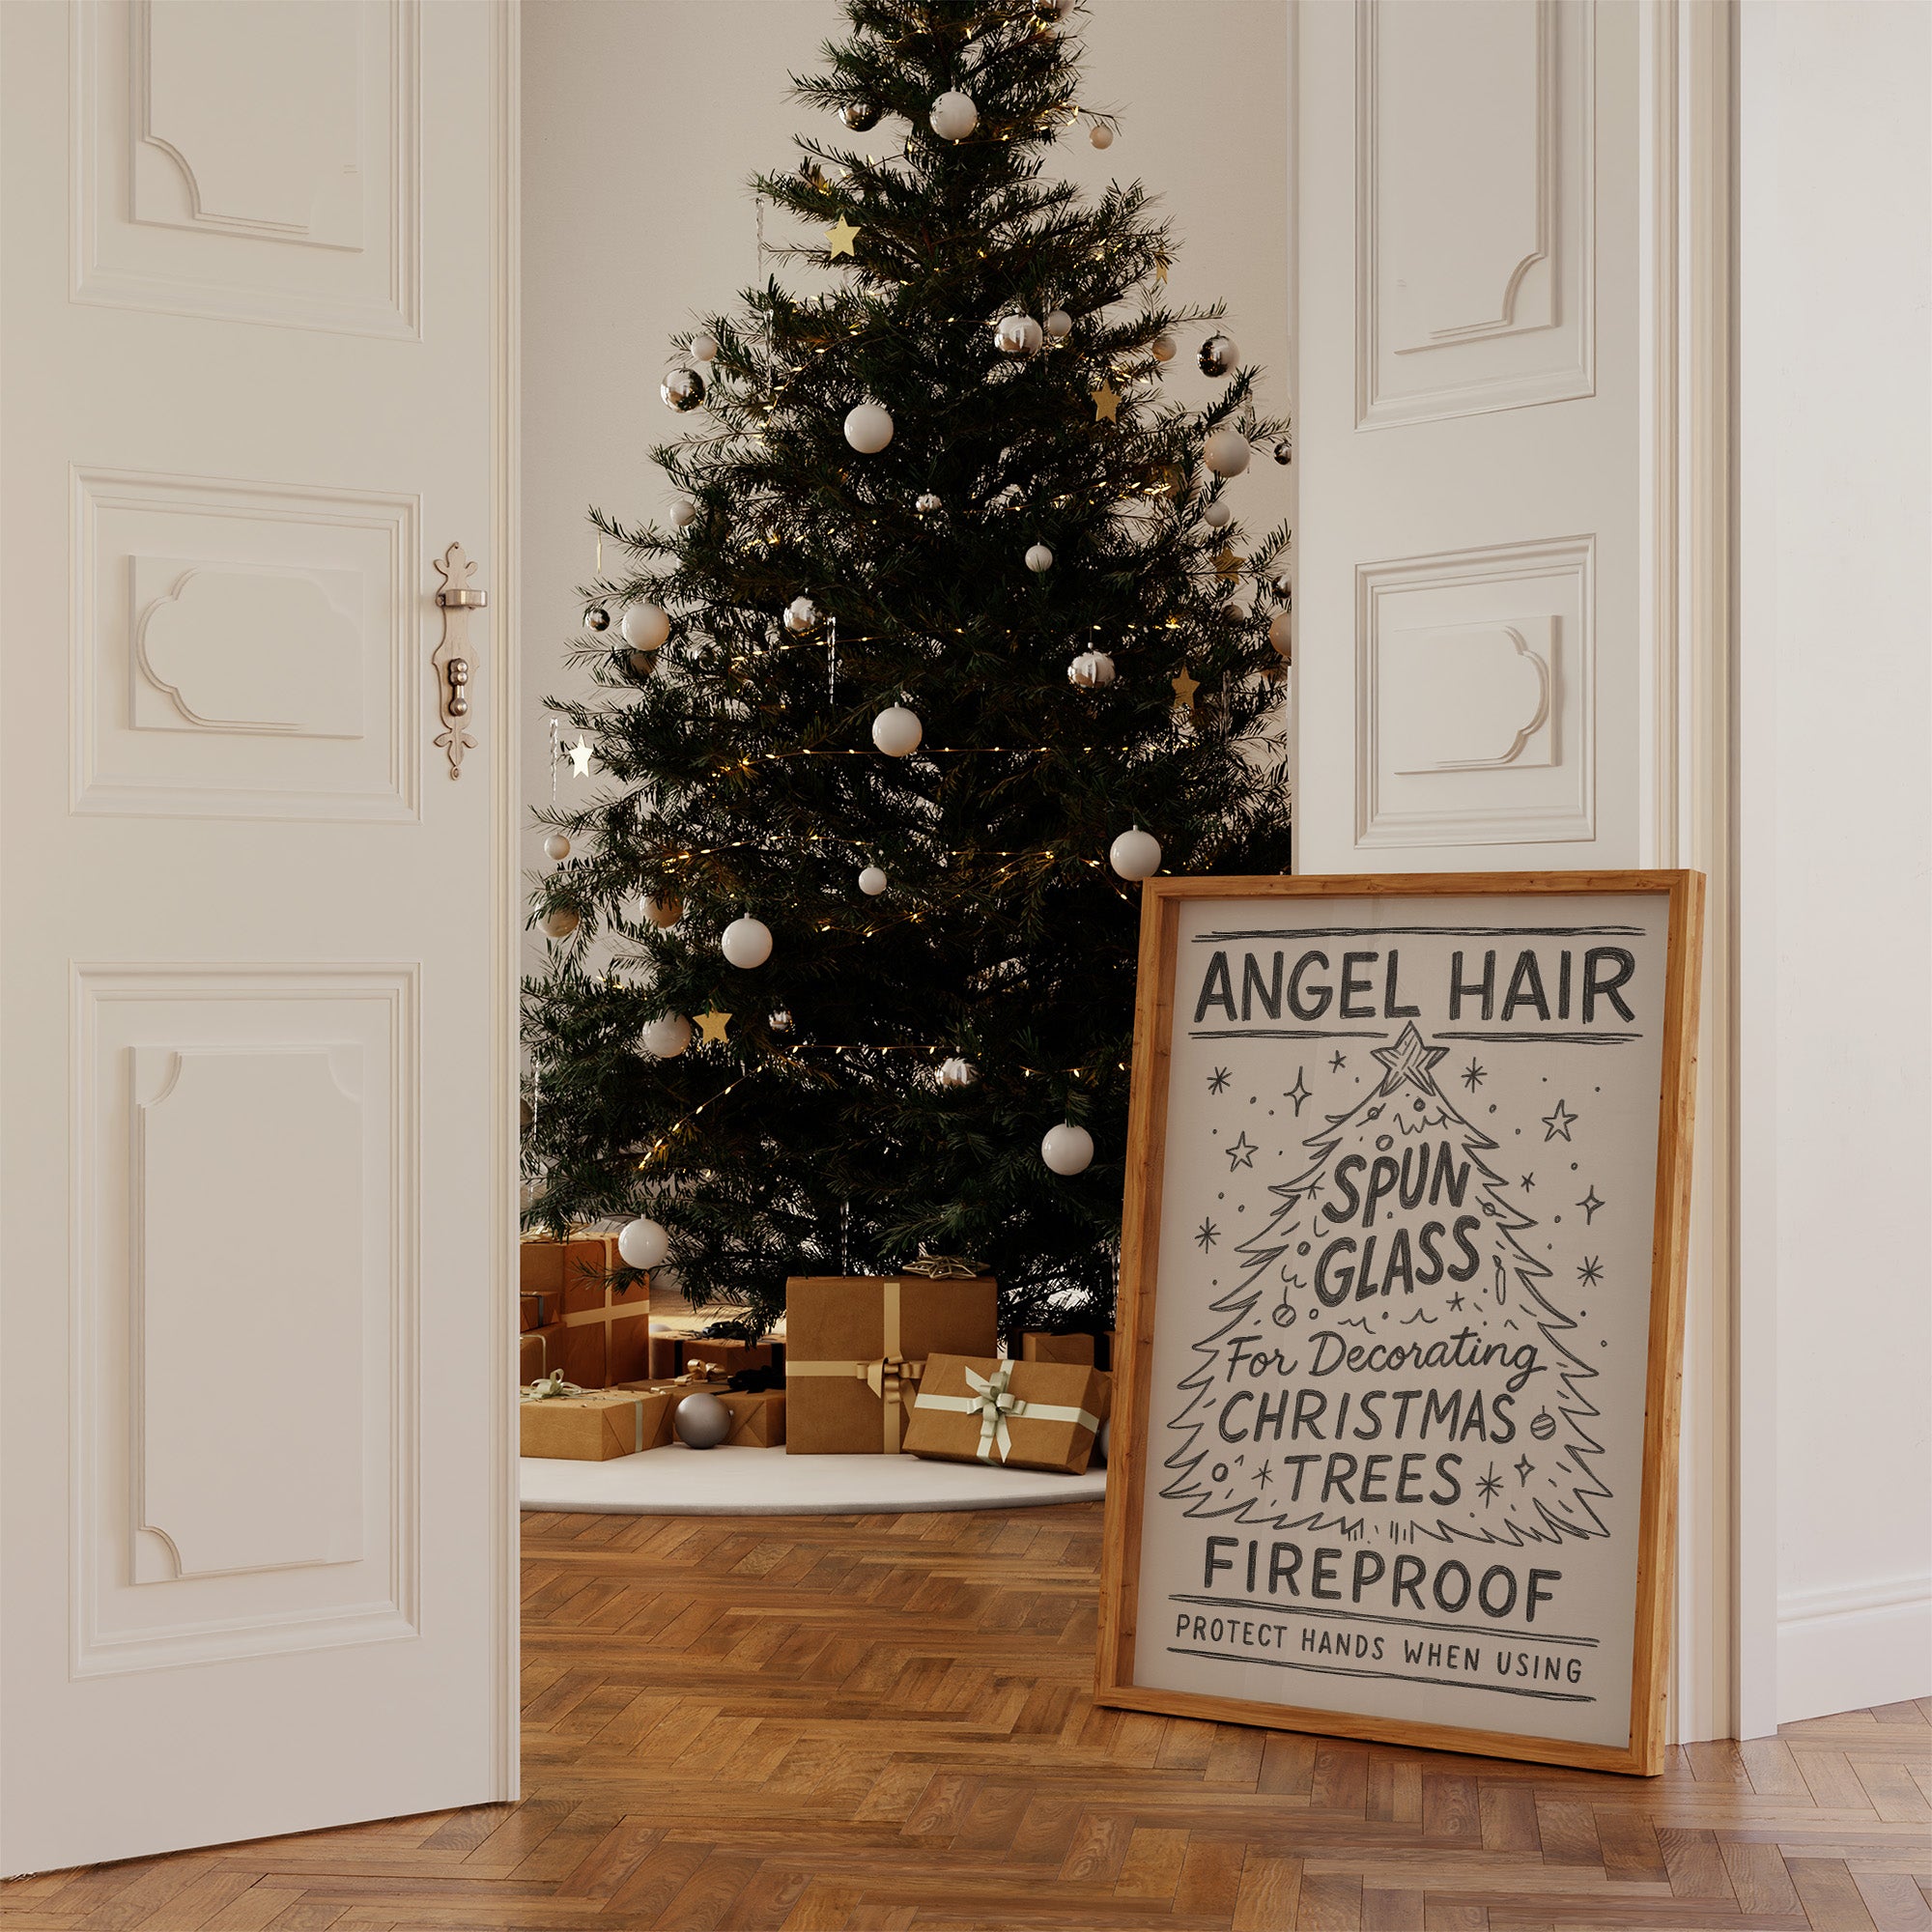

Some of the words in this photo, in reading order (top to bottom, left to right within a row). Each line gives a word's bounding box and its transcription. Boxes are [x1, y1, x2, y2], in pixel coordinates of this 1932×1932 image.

[1194, 949, 1421, 1022] ANGEL
[1449, 946, 1635, 1024] HAIR
[1321, 1141, 1471, 1228] SPUN
[1314, 1215, 1481, 1307] GLASS
[1226, 1335, 1297, 1382] For
[1307, 1327, 1547, 1393] Decorating
[1218, 1388, 1517, 1444] CHRISTMAS
[1284, 1452, 1463, 1505] TREES
[1204, 1536, 1562, 1623] FIREPROOF
[1177, 1612, 1288, 1650] PROTECT
[1301, 1628, 1385, 1661] HANDS
[1404, 1639, 1480, 1672] WHEN
[1496, 1651, 1582, 1684] USING
